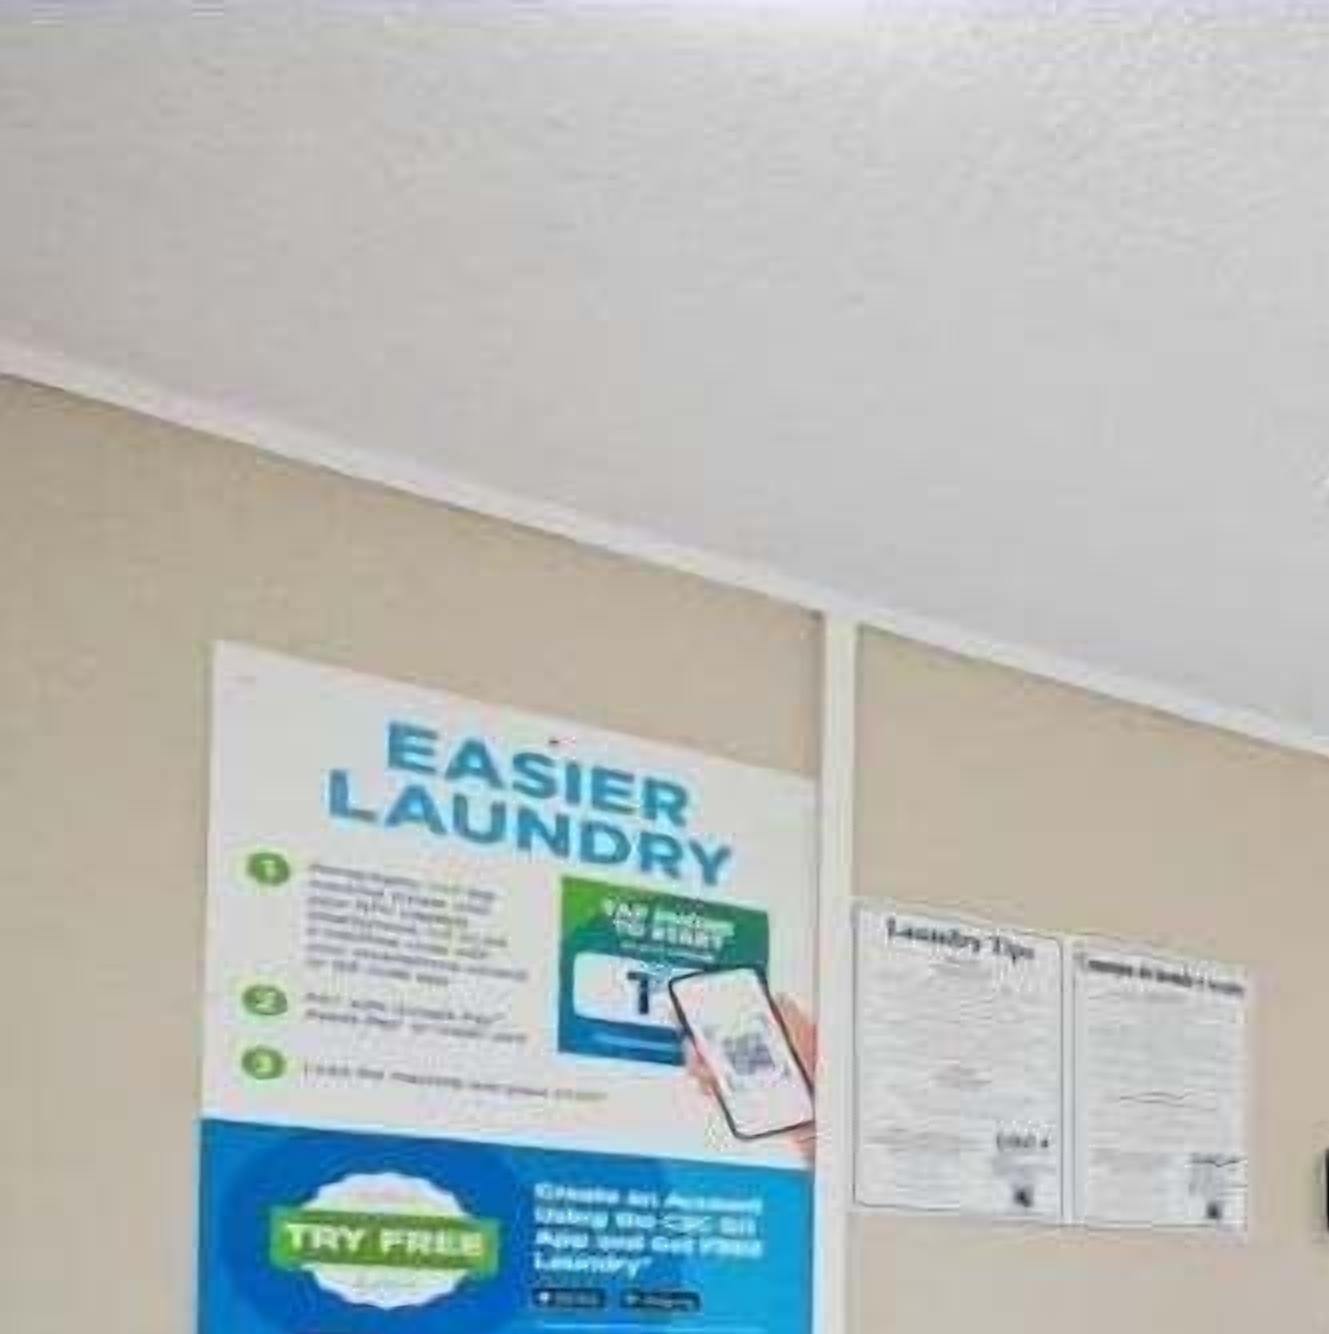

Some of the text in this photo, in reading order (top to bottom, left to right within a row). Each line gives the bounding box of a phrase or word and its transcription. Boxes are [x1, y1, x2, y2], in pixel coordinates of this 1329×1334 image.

[386, 720, 690, 829] EASIER
[328, 768, 733, 888] LAUNDRY
[886, 917, 1035, 964] Laundry Tips
[534, 1182, 621, 1206] Create
[626, 1191, 659, 1209] an
[534, 1207, 610, 1231] Using
[614, 1211, 657, 1231] the
[285, 1222, 484, 1257] TRY FREE
[535, 1230, 589, 1252] App
